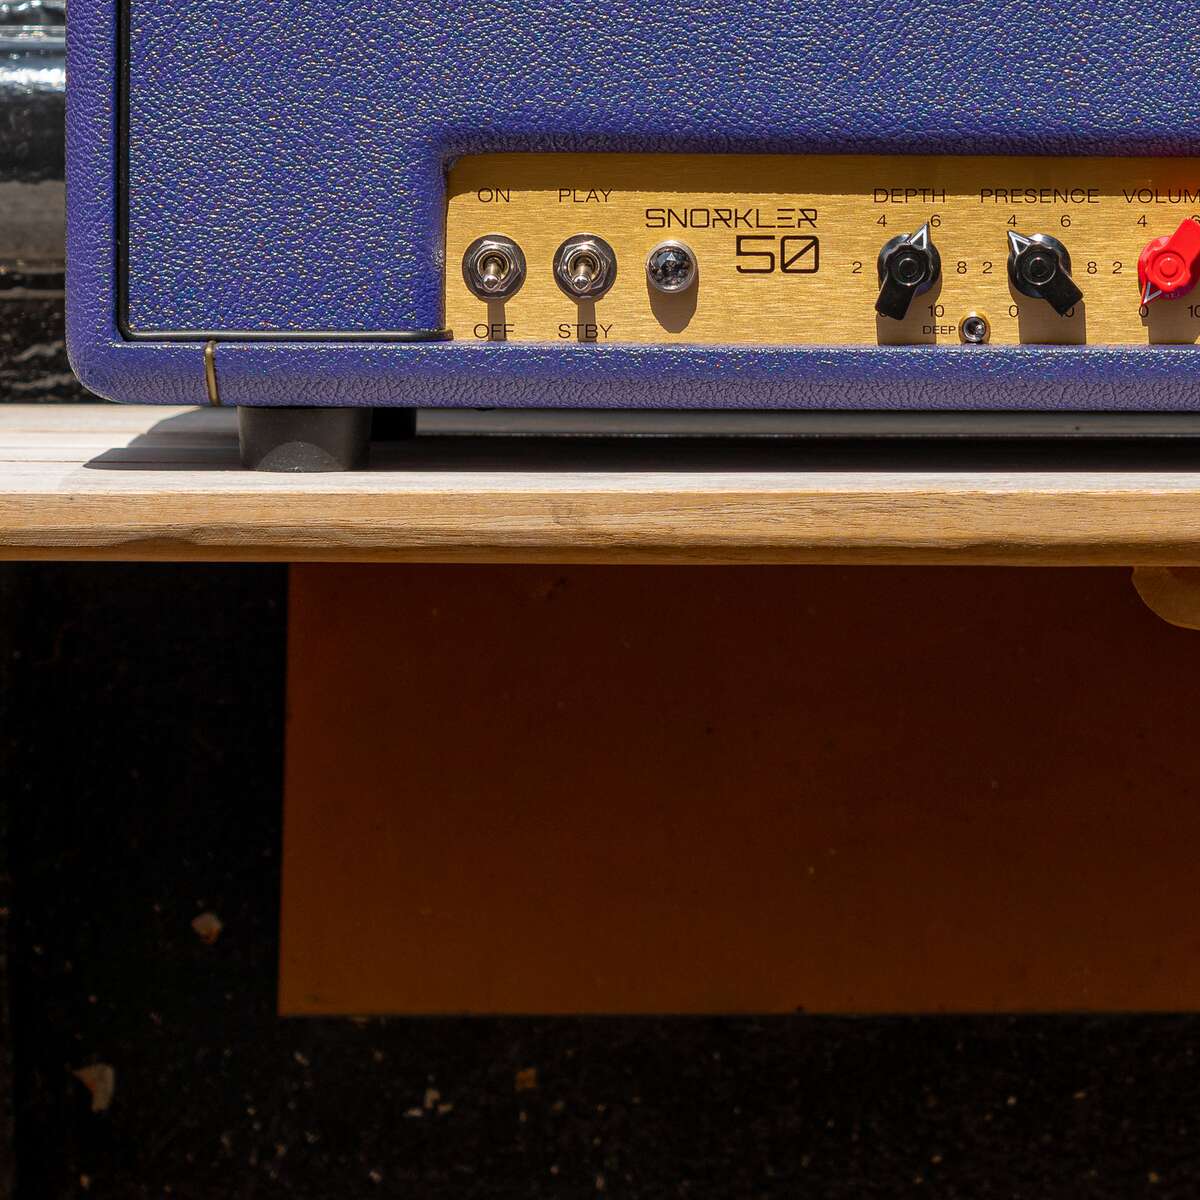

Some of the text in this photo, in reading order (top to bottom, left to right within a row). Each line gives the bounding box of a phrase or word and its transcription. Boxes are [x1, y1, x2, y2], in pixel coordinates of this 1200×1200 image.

[477, 188, 510, 202] ON
[559, 188, 613, 202] PLAY
[873, 188, 945, 203] DEPTH
[980, 189, 1099, 203] PRESENCE
[646, 208, 818, 228] SNORKLER
[877, 215, 888, 227] 4
[930, 215, 941, 227] 6
[1007, 215, 1018, 227] 4
[1061, 215, 1071, 227] 6
[1137, 215, 1147, 227] 4
[736, 235, 819, 273] 50
[852, 262, 862, 274] 2
[957, 262, 967, 274] 8
[982, 262, 992, 274] 2
[1087, 262, 1097, 274] 8
[1112, 262, 1122, 274] 2
[928, 305, 944, 318] 10
[473, 324, 514, 338] OFF
[559, 324, 613, 338] STBY
[923, 326, 956, 335] DEEP
